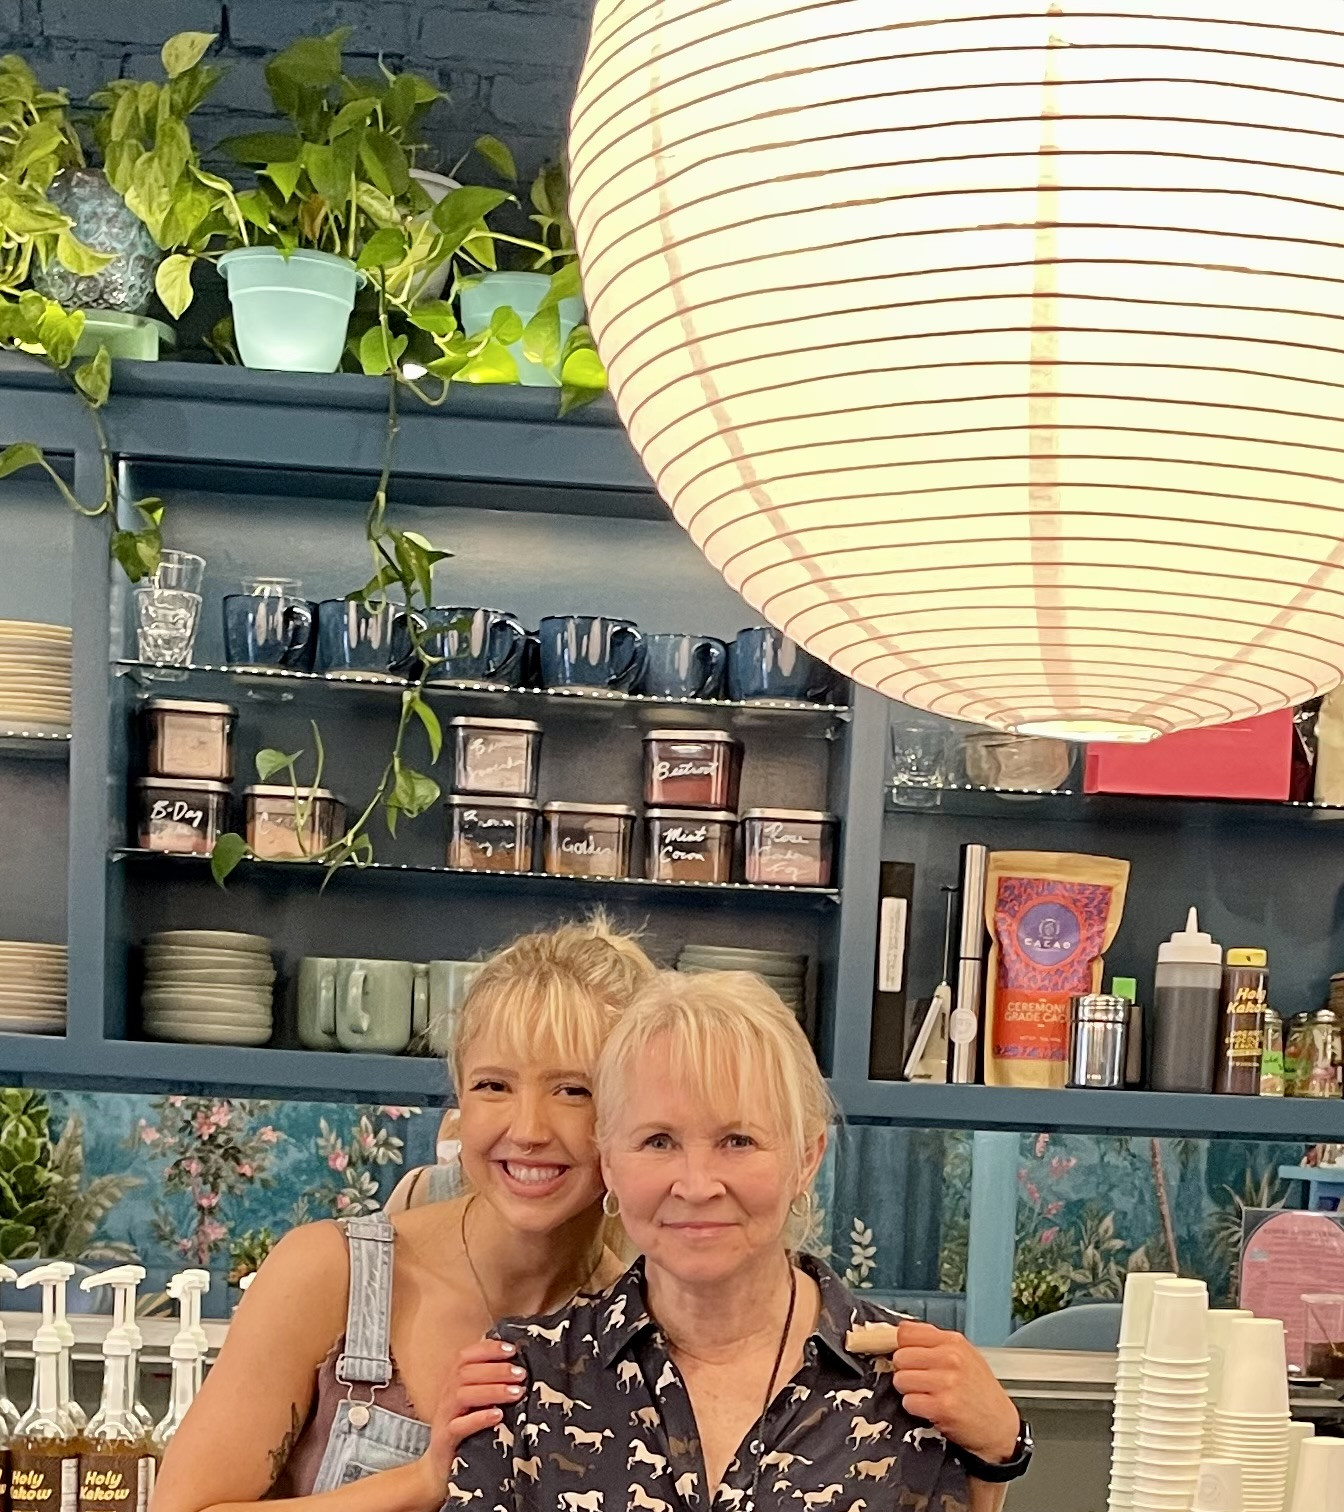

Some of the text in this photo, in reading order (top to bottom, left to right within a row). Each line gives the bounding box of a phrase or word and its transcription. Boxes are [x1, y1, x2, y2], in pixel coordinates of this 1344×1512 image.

[1024, 937, 1071, 949] CACAO
[1004, 1012, 1066, 1023] GRADE CAC
[12, 1470, 44, 1489] Holy
[85, 1470, 123, 1489] Holy
